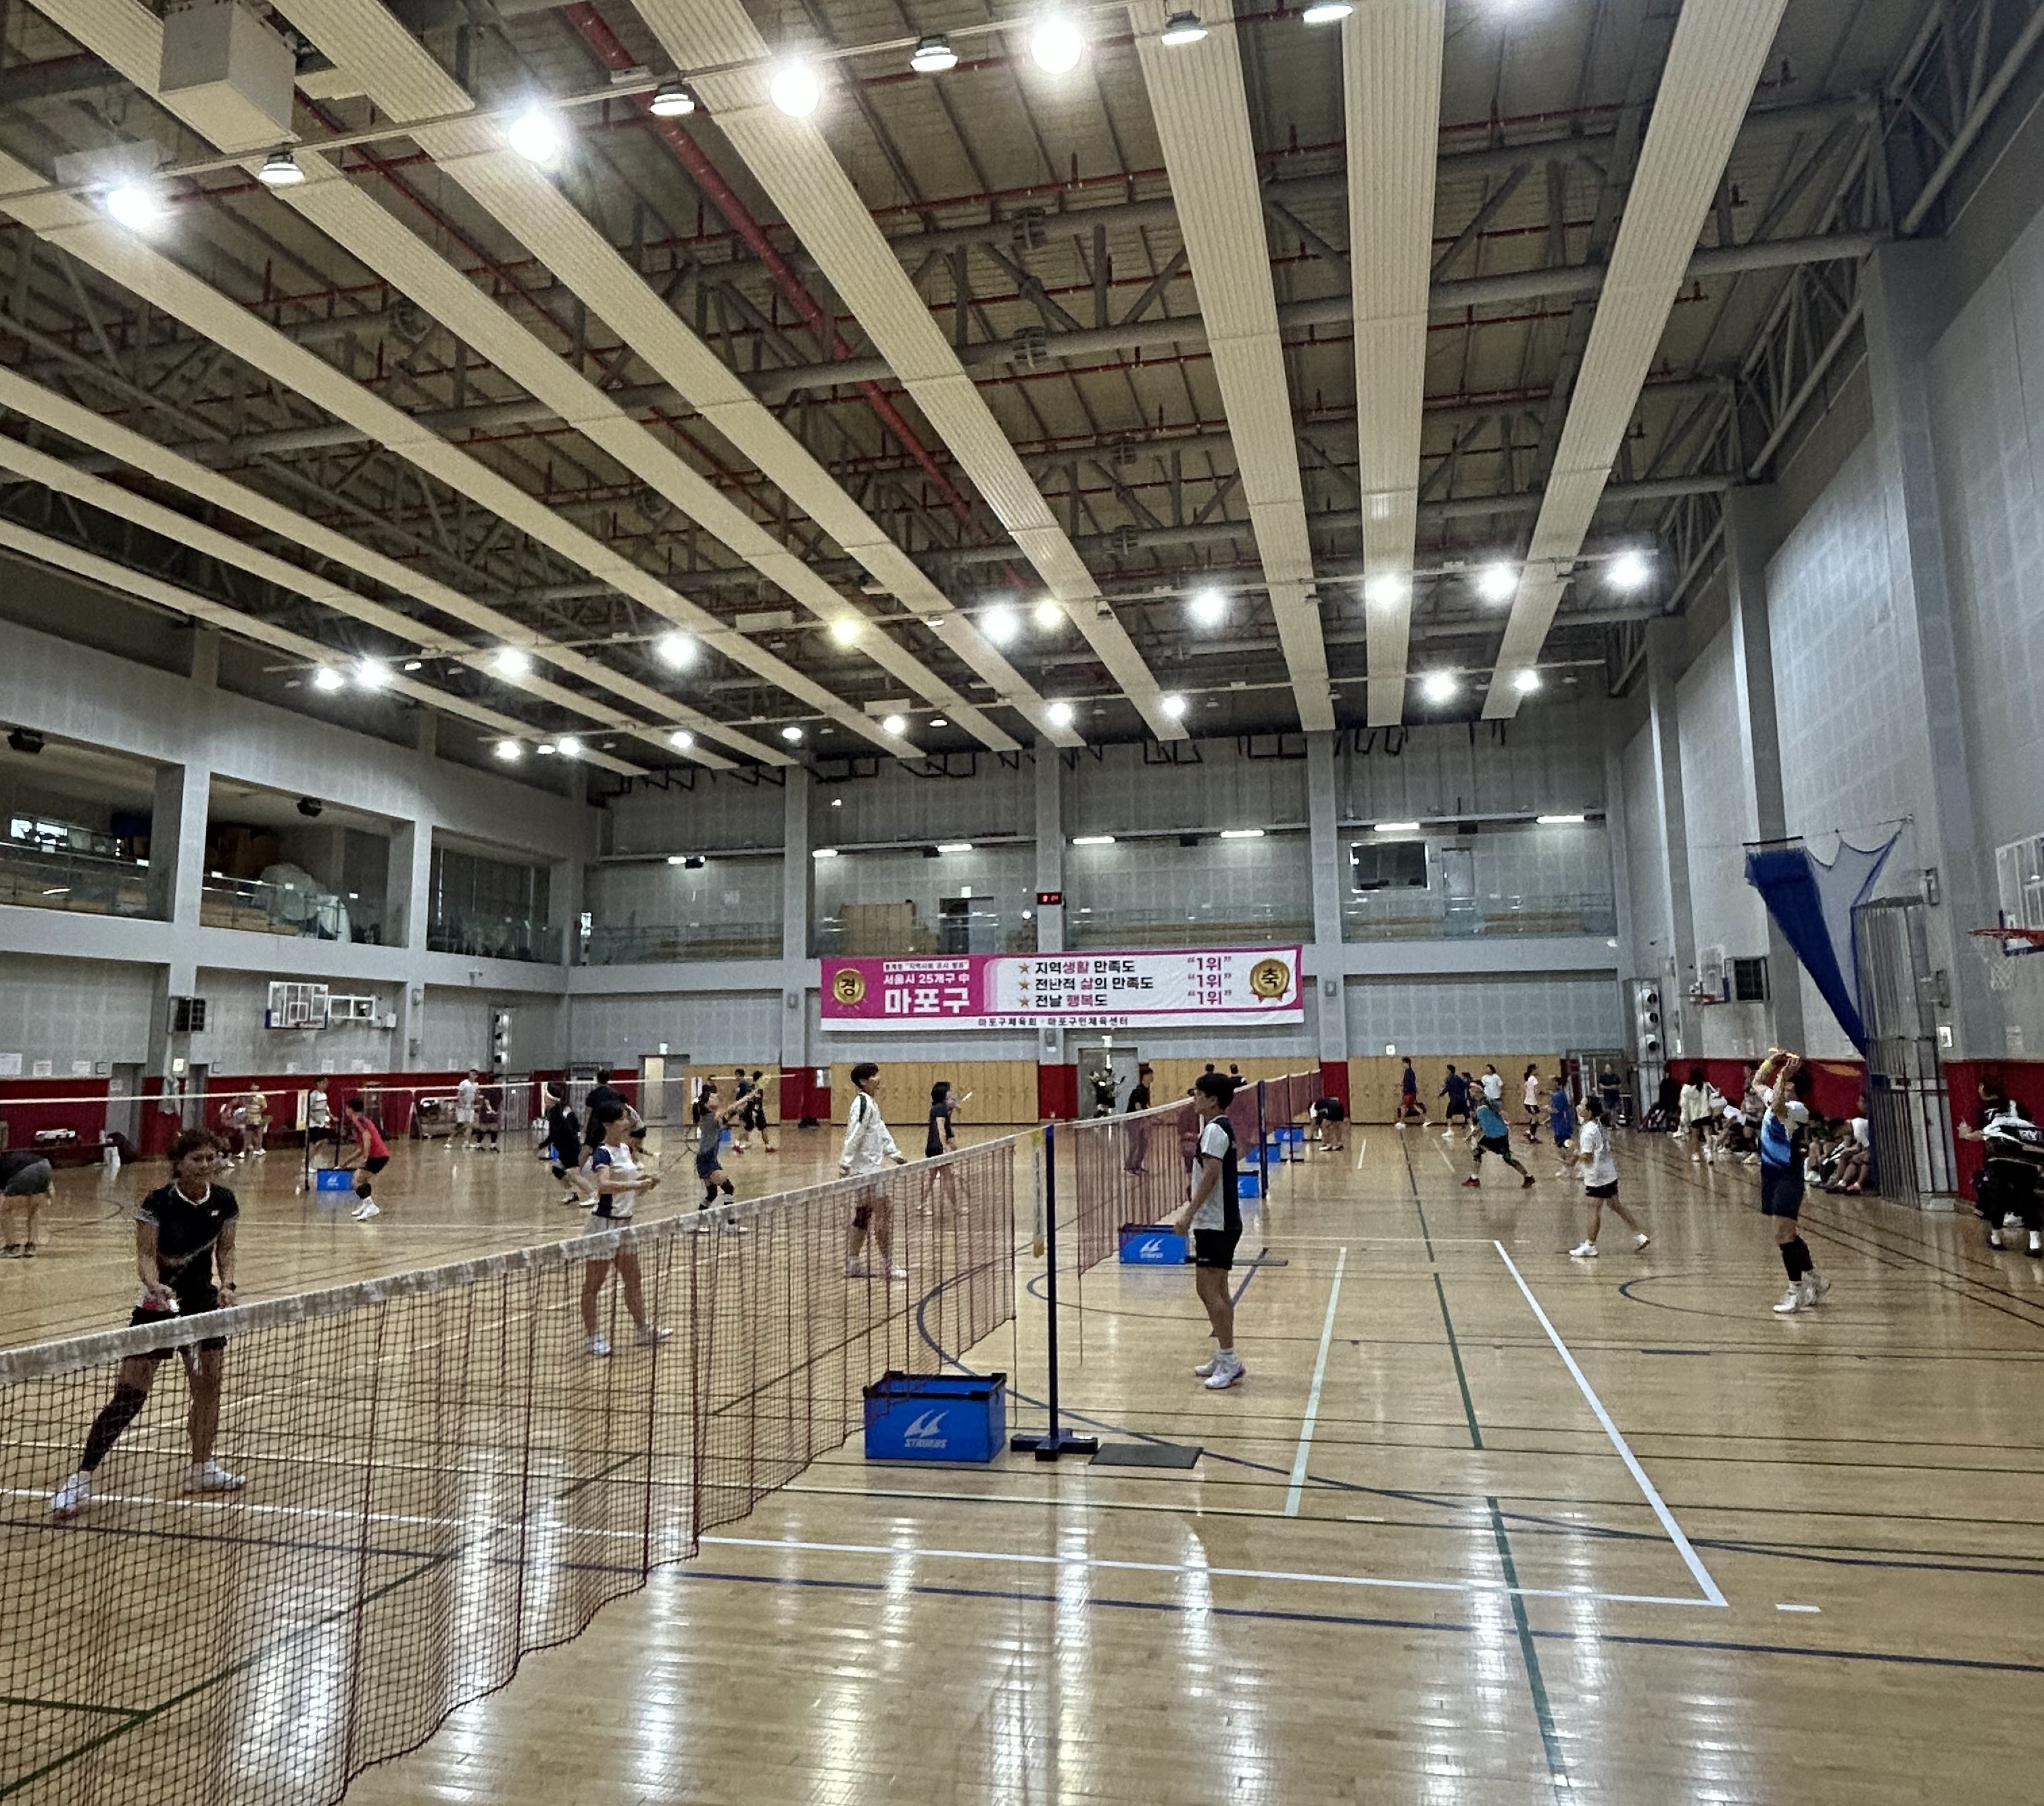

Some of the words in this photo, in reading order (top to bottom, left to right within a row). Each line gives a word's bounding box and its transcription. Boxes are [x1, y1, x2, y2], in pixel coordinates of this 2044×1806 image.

[1036, 960, 1089, 974] 지역생활
[1094, 960, 1135, 973] 만족도
[883, 973, 915, 985] 서울시
[919, 973, 955, 983] 25개구
[1036, 977, 1075, 990] 전반적
[1081, 977, 1106, 990] 삶의
[1112, 977, 1153, 990] 만족도
[1261, 968, 1280, 988] 축
[841, 978, 855, 996] 경
[885, 987, 970, 1013] 마포구
[1036, 994, 1062, 1007] 전날
[1067, 994, 1107, 1006] 행복도
